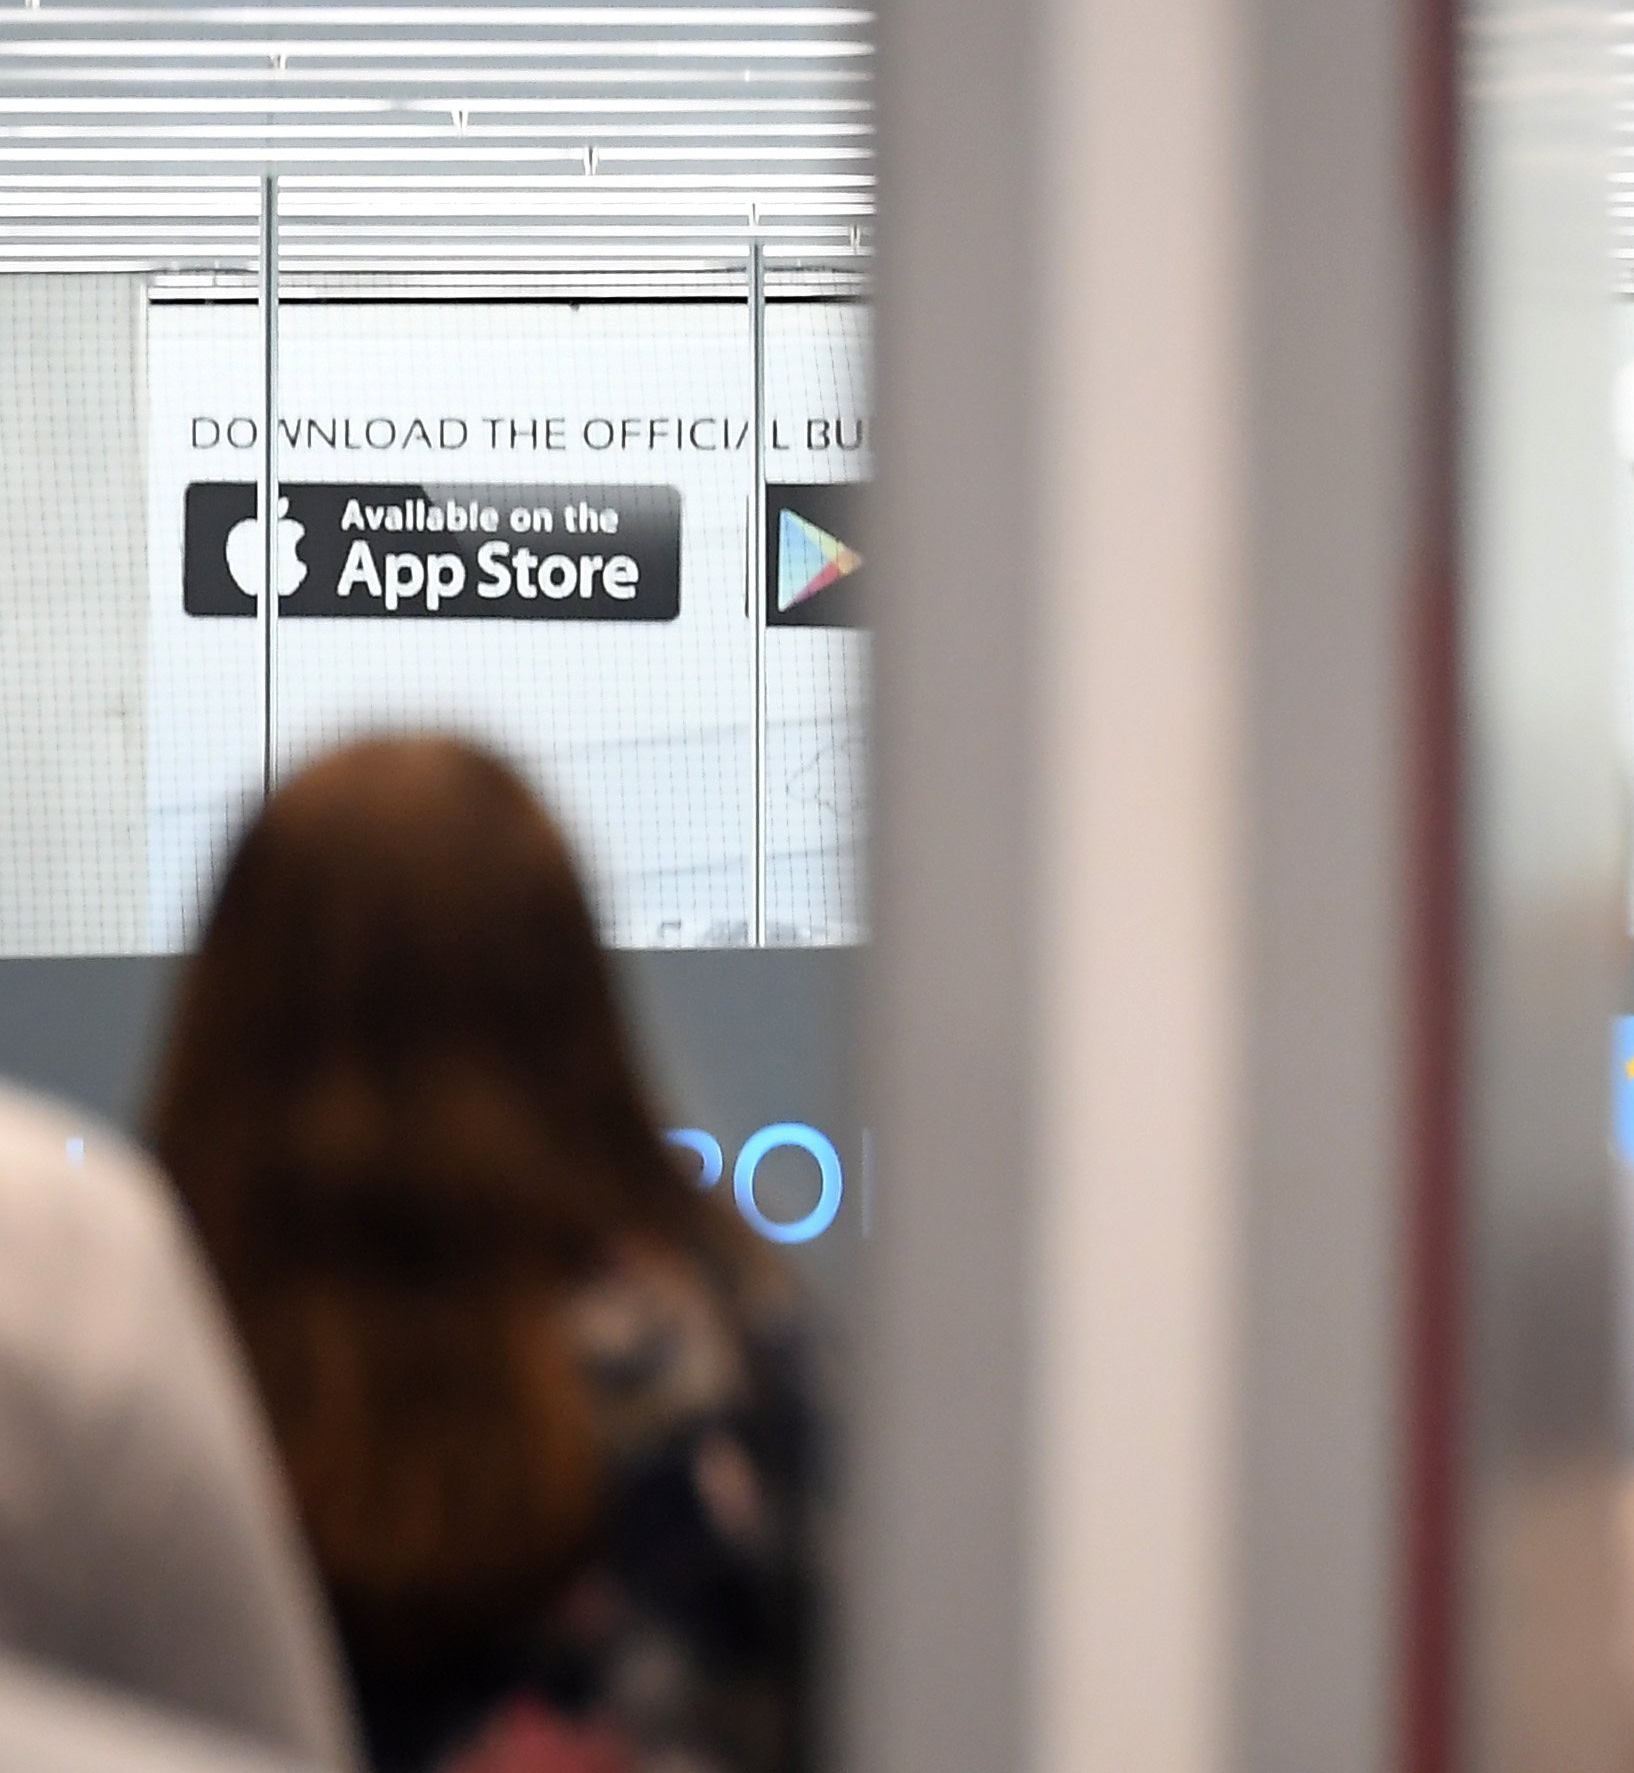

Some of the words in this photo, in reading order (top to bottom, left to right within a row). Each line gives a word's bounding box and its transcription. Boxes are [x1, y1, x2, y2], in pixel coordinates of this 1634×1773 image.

[191, 416, 468, 450] DOWNLOAD
[482, 417, 566, 450] THE
[340, 498, 500, 533] Available
[509, 506, 554, 534] on
[563, 500, 619, 534] the
[337, 539, 467, 612] App
[476, 540, 640, 600] Store
